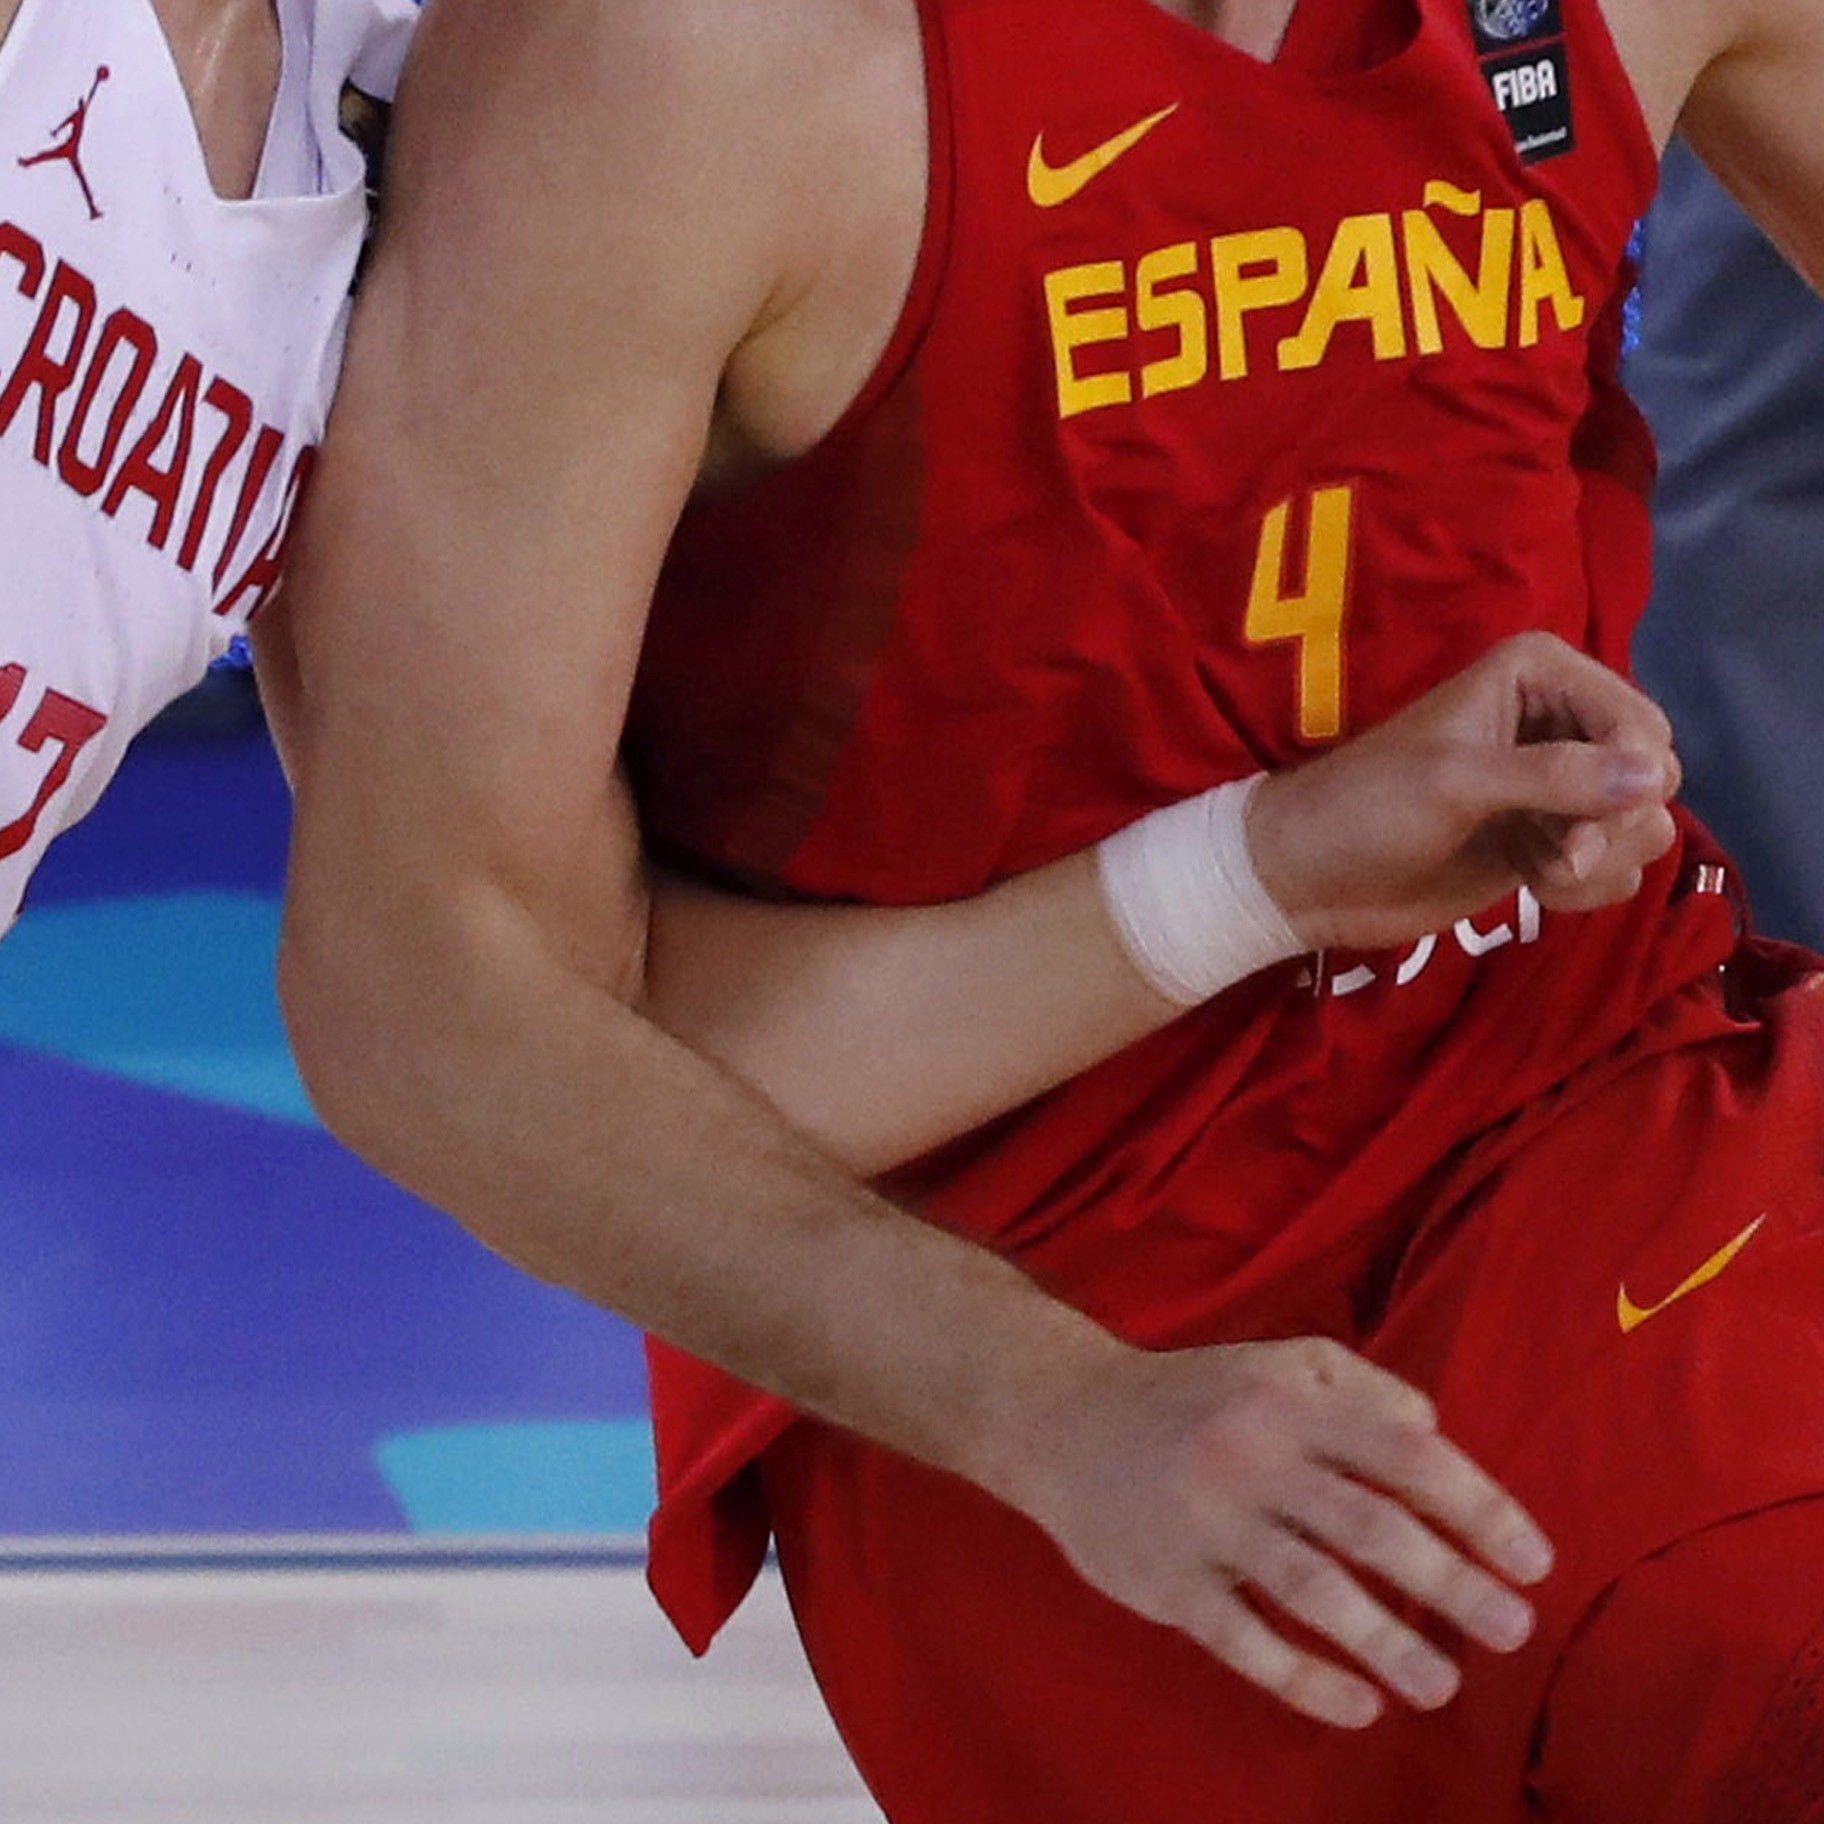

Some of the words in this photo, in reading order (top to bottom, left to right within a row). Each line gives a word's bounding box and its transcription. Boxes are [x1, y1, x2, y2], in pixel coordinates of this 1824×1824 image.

[1491, 58, 1558, 112] FIBA
[1042, 178, 1586, 420] ESPAÑA
[1242, 477, 1364, 746] 4
